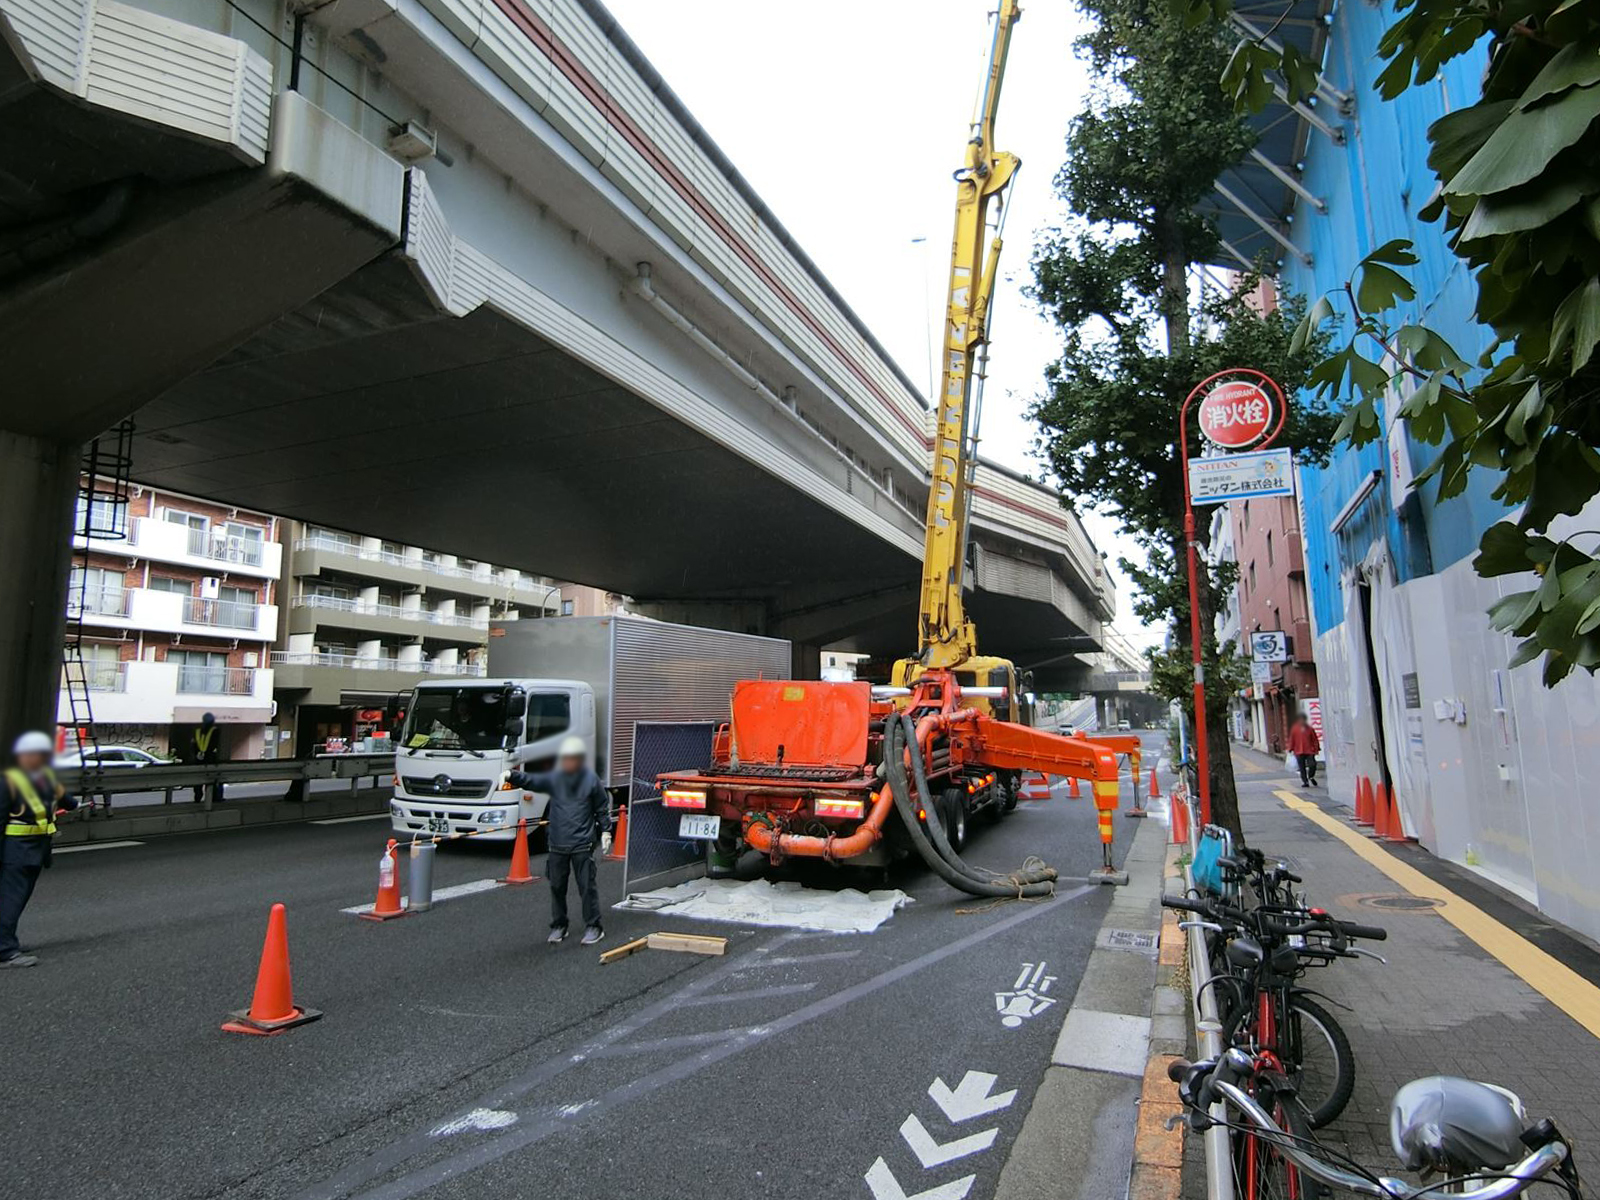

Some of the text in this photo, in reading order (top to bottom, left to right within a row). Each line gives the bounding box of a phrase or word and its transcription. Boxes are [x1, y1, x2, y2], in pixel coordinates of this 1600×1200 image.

[1225, 389, 1255, 400] HYDRANT
[1207, 399, 1265, 430] 消火栓
[1197, 460, 1238, 471] NITTAN
[936, 437, 958, 527] FUJI
[1199, 477, 1284, 495] ニッタン株式会社
